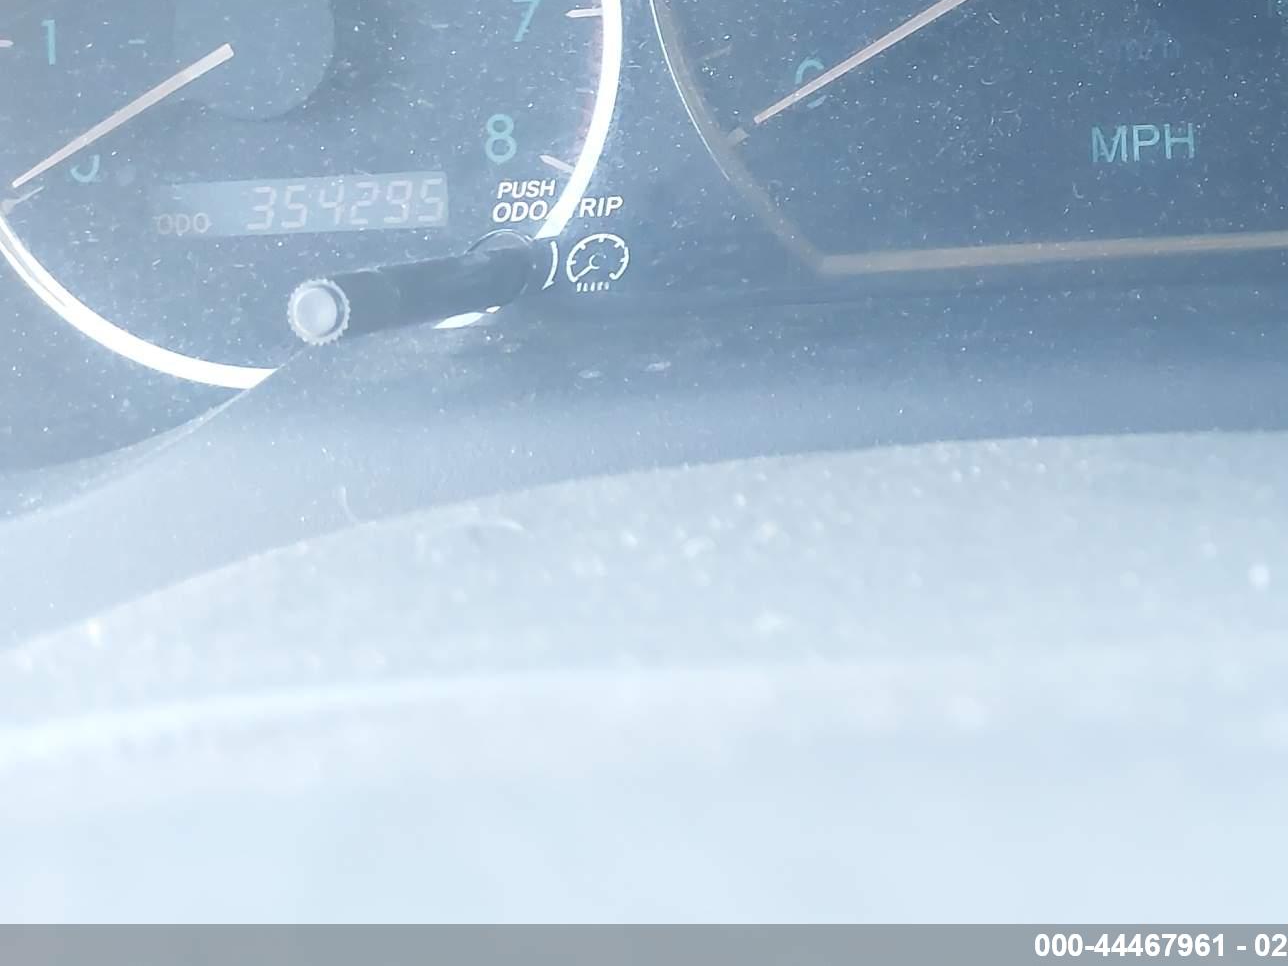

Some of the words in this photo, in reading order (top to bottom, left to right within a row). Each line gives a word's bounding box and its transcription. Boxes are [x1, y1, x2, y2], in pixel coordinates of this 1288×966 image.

[42, 19, 58, 65] 1
[484, 114, 516, 163] 8
[1091, 122, 1196, 166] MPH
[246, 178, 447, 230] 354295
[498, 179, 557, 199] PUSH
[155, 213, 210, 235] ODO
